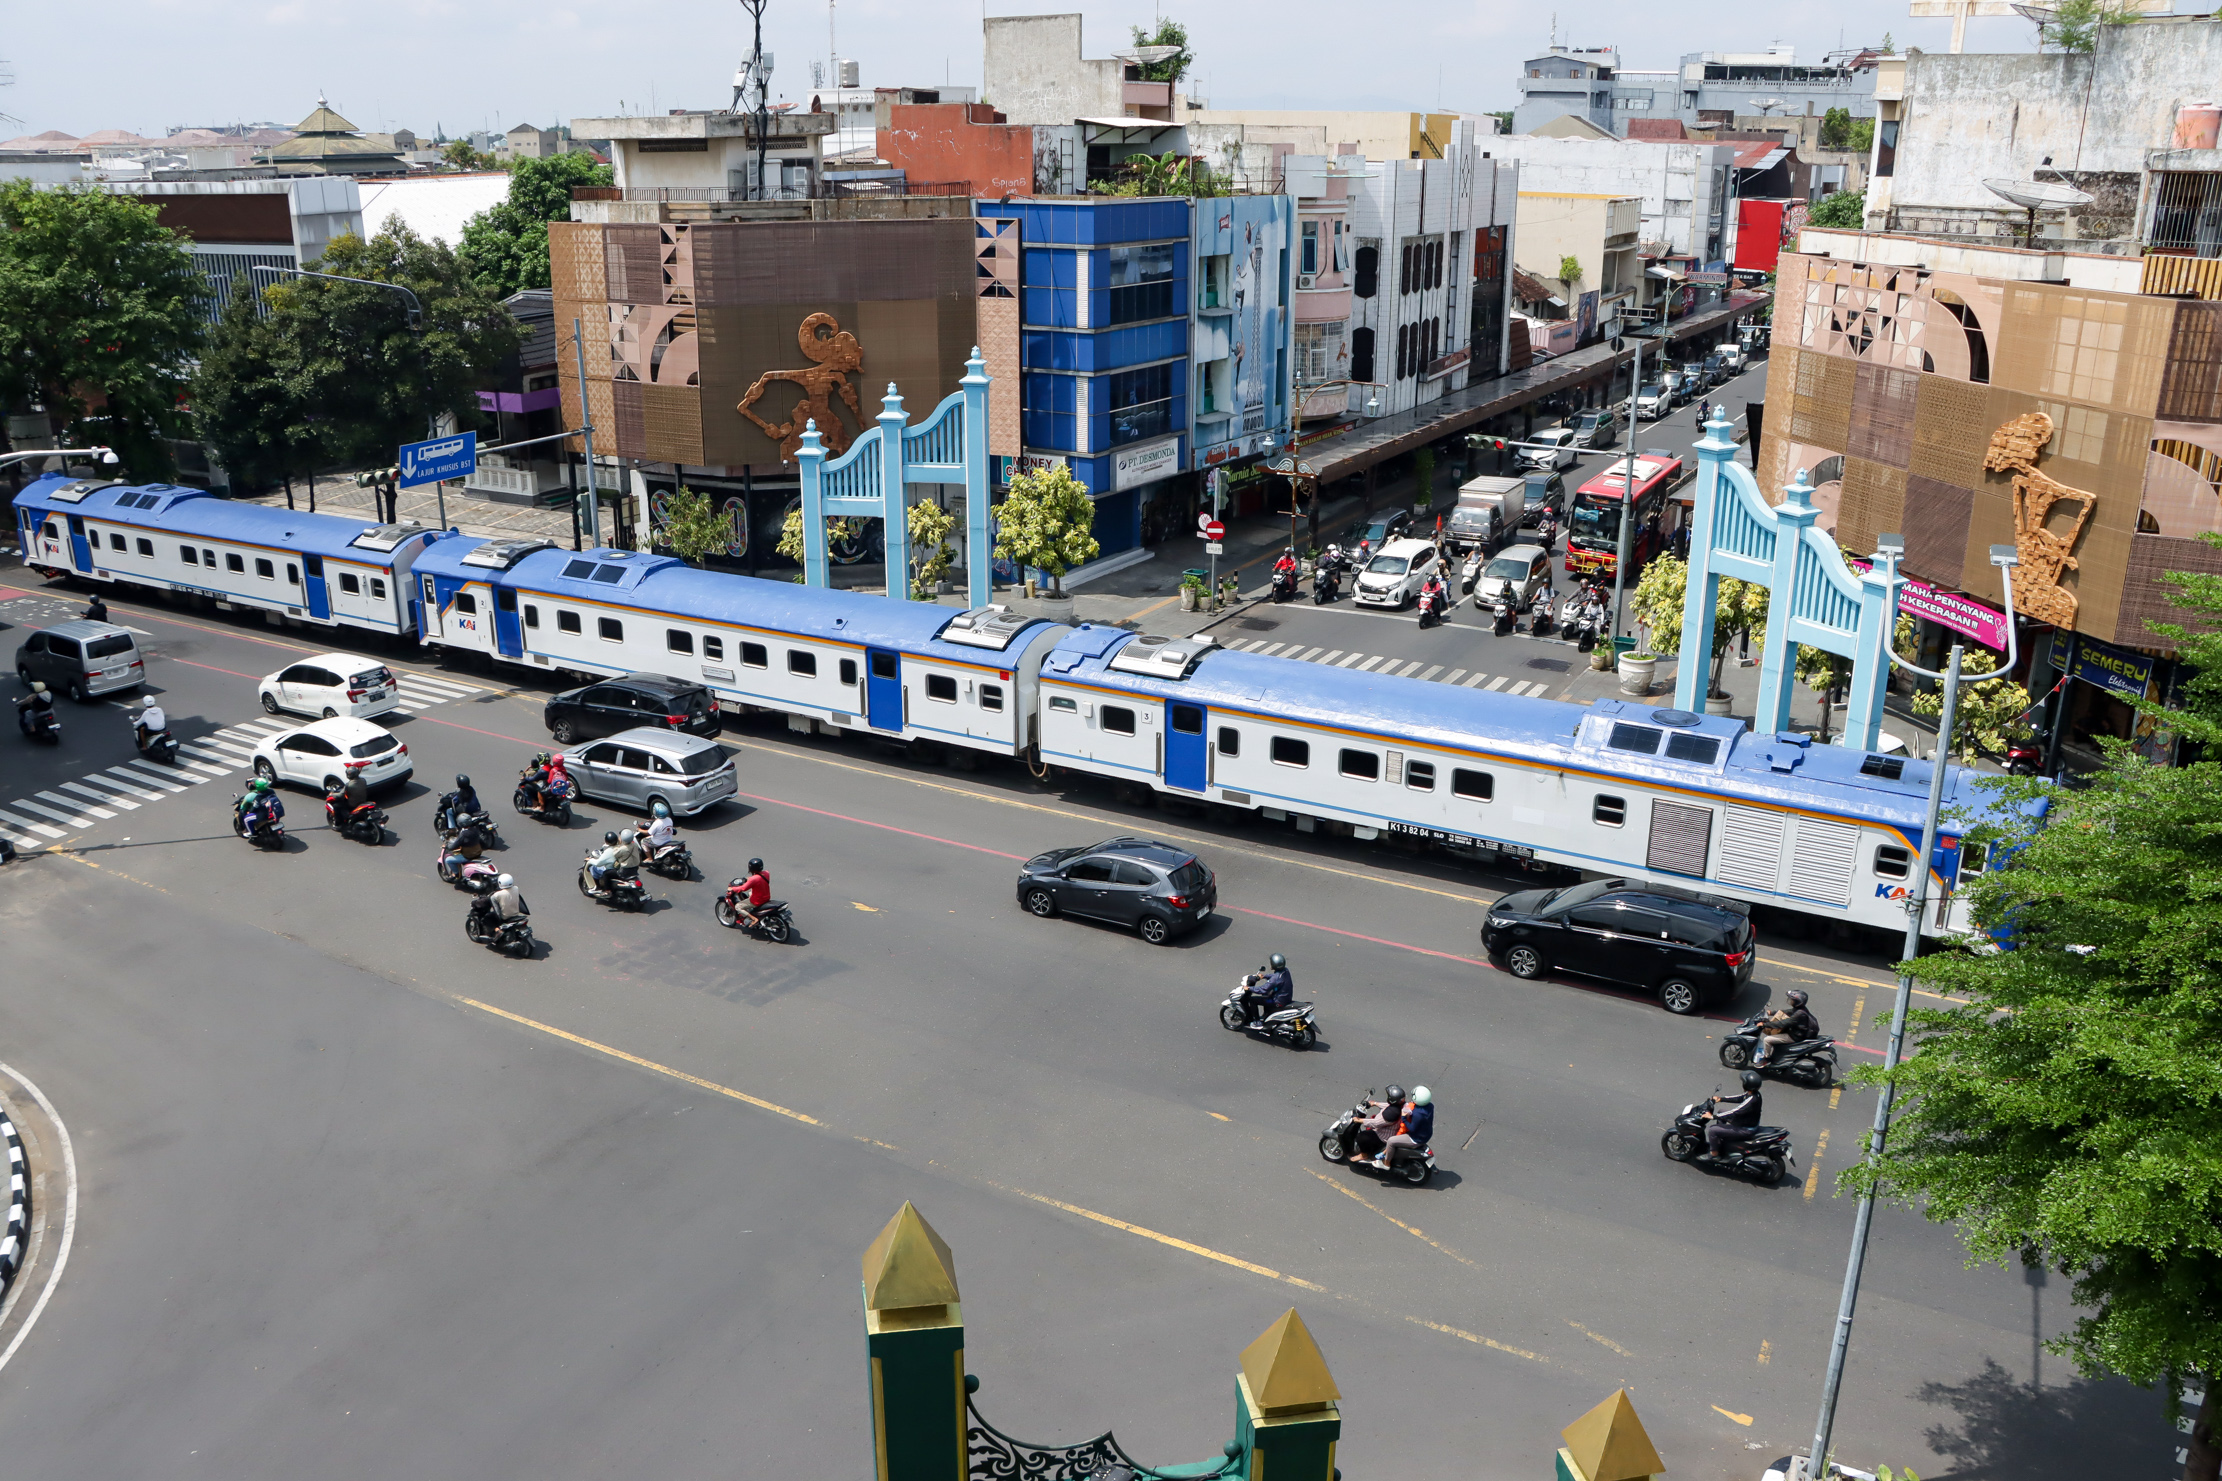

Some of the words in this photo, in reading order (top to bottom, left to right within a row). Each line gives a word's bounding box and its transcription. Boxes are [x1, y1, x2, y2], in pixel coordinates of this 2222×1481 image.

[1139, 447, 1175, 465] DESMONDA
[417, 467, 435, 478] LAJUR
[437, 462, 459, 473] KHUSUS
[461, 460, 471, 468] BST
[1908, 595, 1972, 628] KEKERASAN
[2081, 648, 2148, 682] SEMERU
[2108, 675, 2143, 694] Elektronik
[1390, 822, 1400, 832] K1
[1402, 825, 1408, 833] 3
[1409, 826, 1418, 835] 82
[1420, 829, 1429, 837] 04
